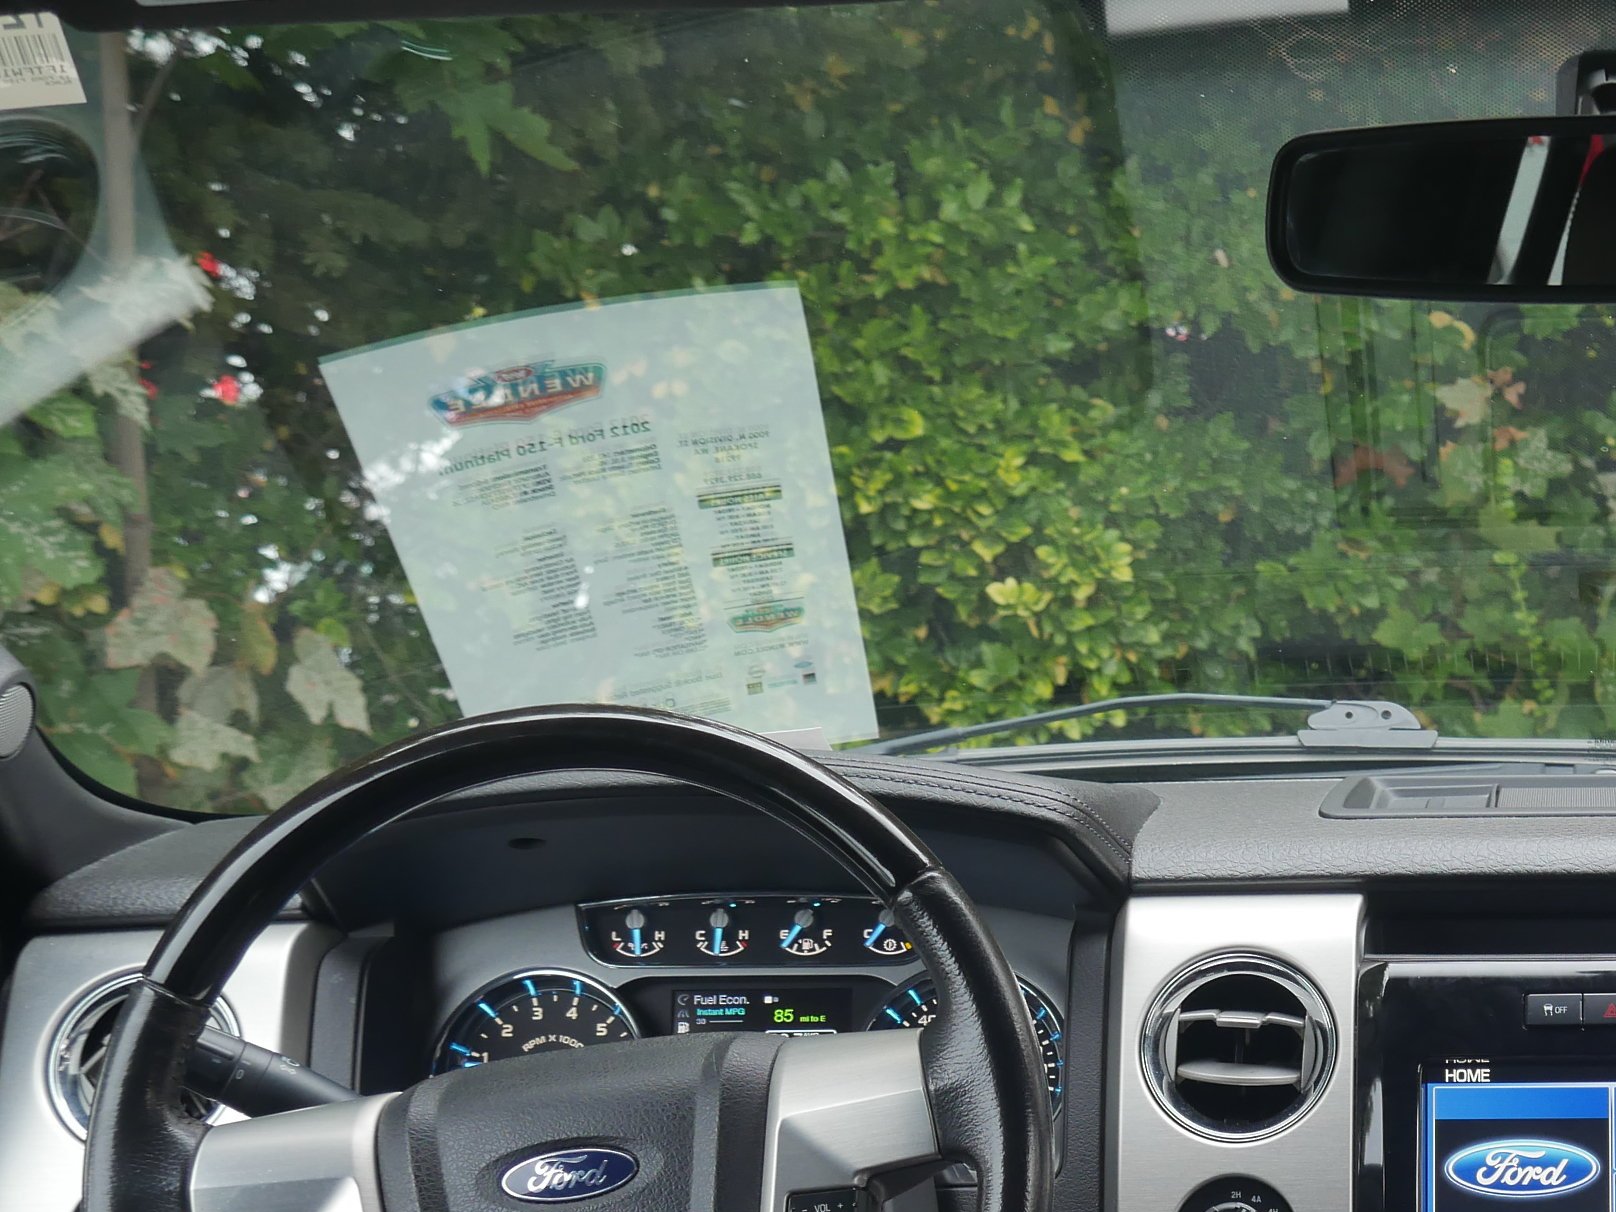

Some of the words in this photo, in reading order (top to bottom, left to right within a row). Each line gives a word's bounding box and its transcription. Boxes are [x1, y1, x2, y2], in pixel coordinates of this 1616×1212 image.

[654, 930, 666, 942] H
[696, 930, 706, 941] C
[738, 929, 750, 940] H
[780, 929, 789, 940] E
[822, 928, 833, 940] F
[693, 994, 717, 1004] Fuel
[718, 994, 750, 1004] Econ.
[532, 1007, 544, 1020] 3
[565, 1007, 578, 1020] 4
[696, 1008, 724, 1016] Instant
[724, 1008, 746, 1016] MPG
[774, 1008, 794, 1023] 85
[1554, 1006, 1568, 1014] OFF
[500, 1024, 514, 1038] 2
[596, 1023, 608, 1037] 5
[522, 1036, 547, 1053] RPM
[481, 1052, 488, 1064] 1
[1444, 1068, 1491, 1083] HOME
[526, 1154, 609, 1194] Ford
[1476, 1150, 1570, 1186] Ford
[1230, 1190, 1242, 1199] 2H
[1250, 1195, 1262, 1204] 4A
